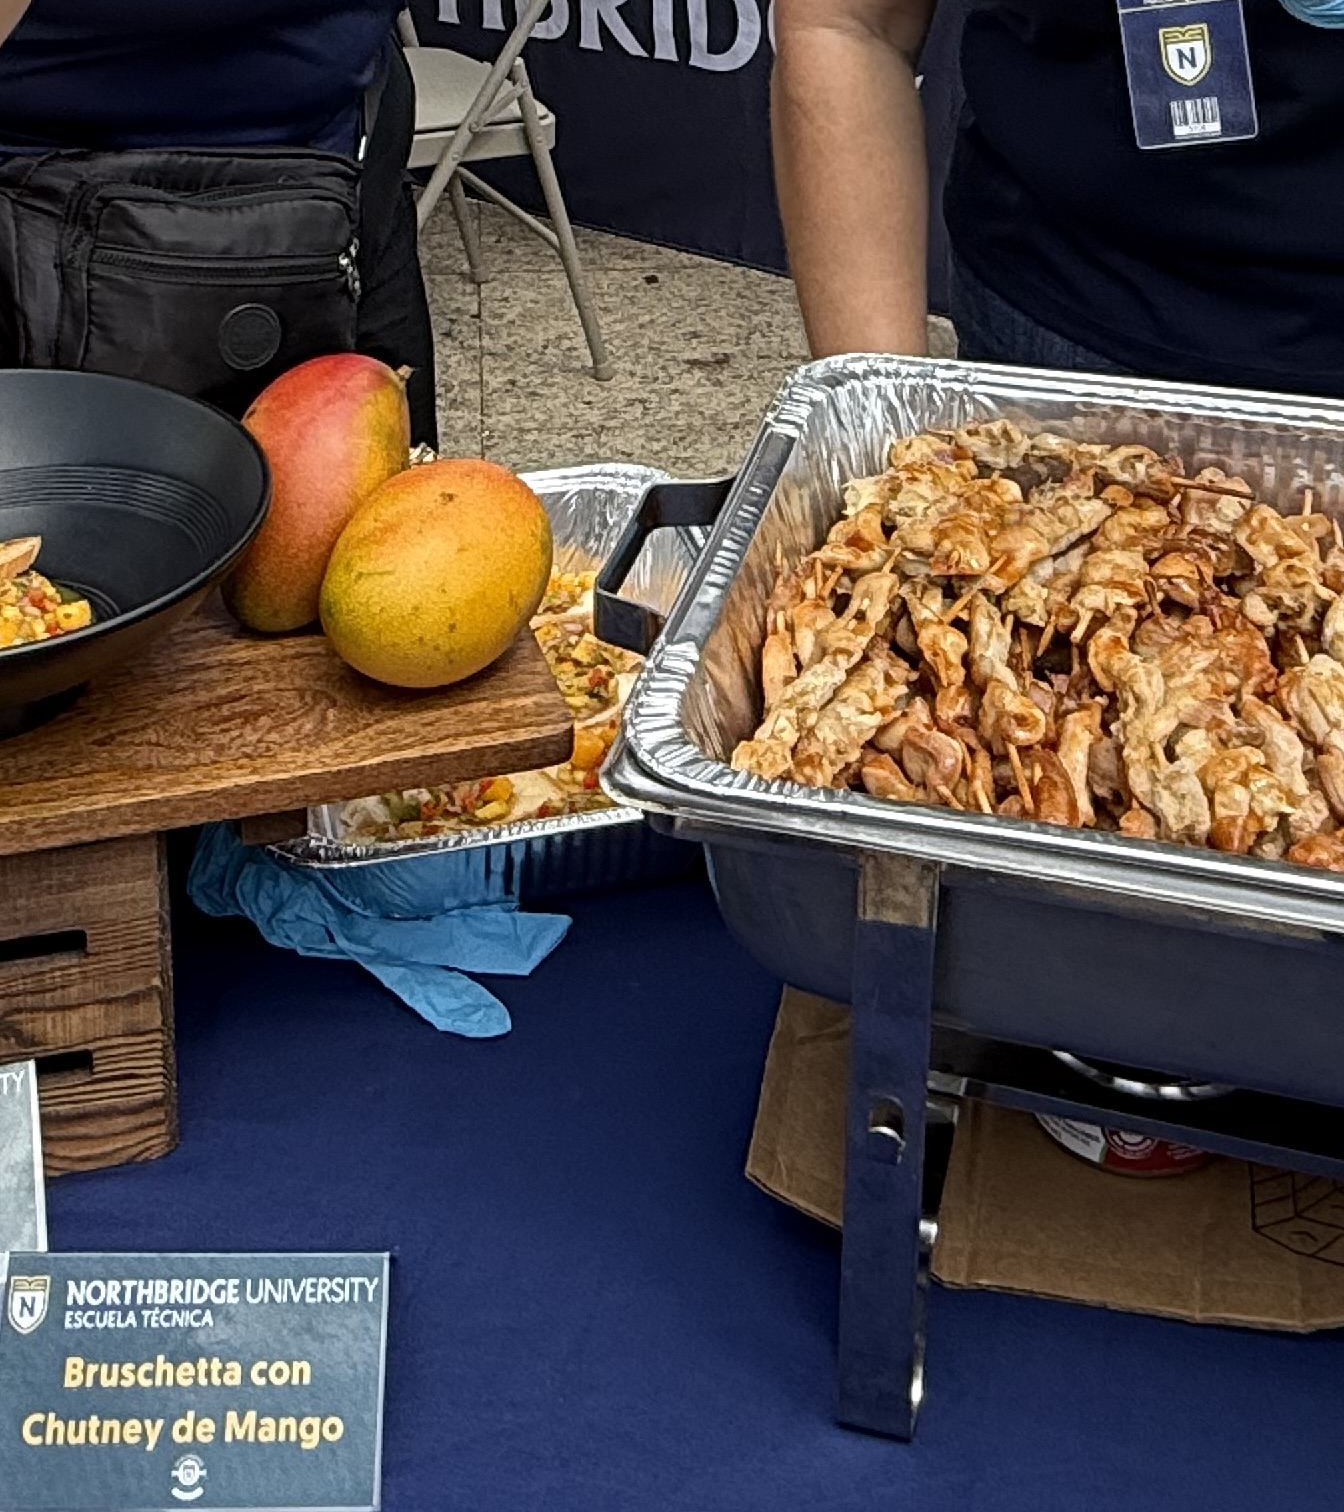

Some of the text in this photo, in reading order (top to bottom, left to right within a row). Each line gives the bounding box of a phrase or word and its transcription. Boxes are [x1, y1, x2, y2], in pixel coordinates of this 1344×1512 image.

[1176, 46, 1198, 70] N
[66, 1276, 379, 1306] NORTHBRIDGE UNIVERSITY
[18, 1296, 37, 1318] N
[64, 1307, 214, 1330] ESCUELA TÉCNICA
[63, 1355, 312, 1388] Bruschetta con
[22, 1410, 345, 1451] Chutney de Mango
